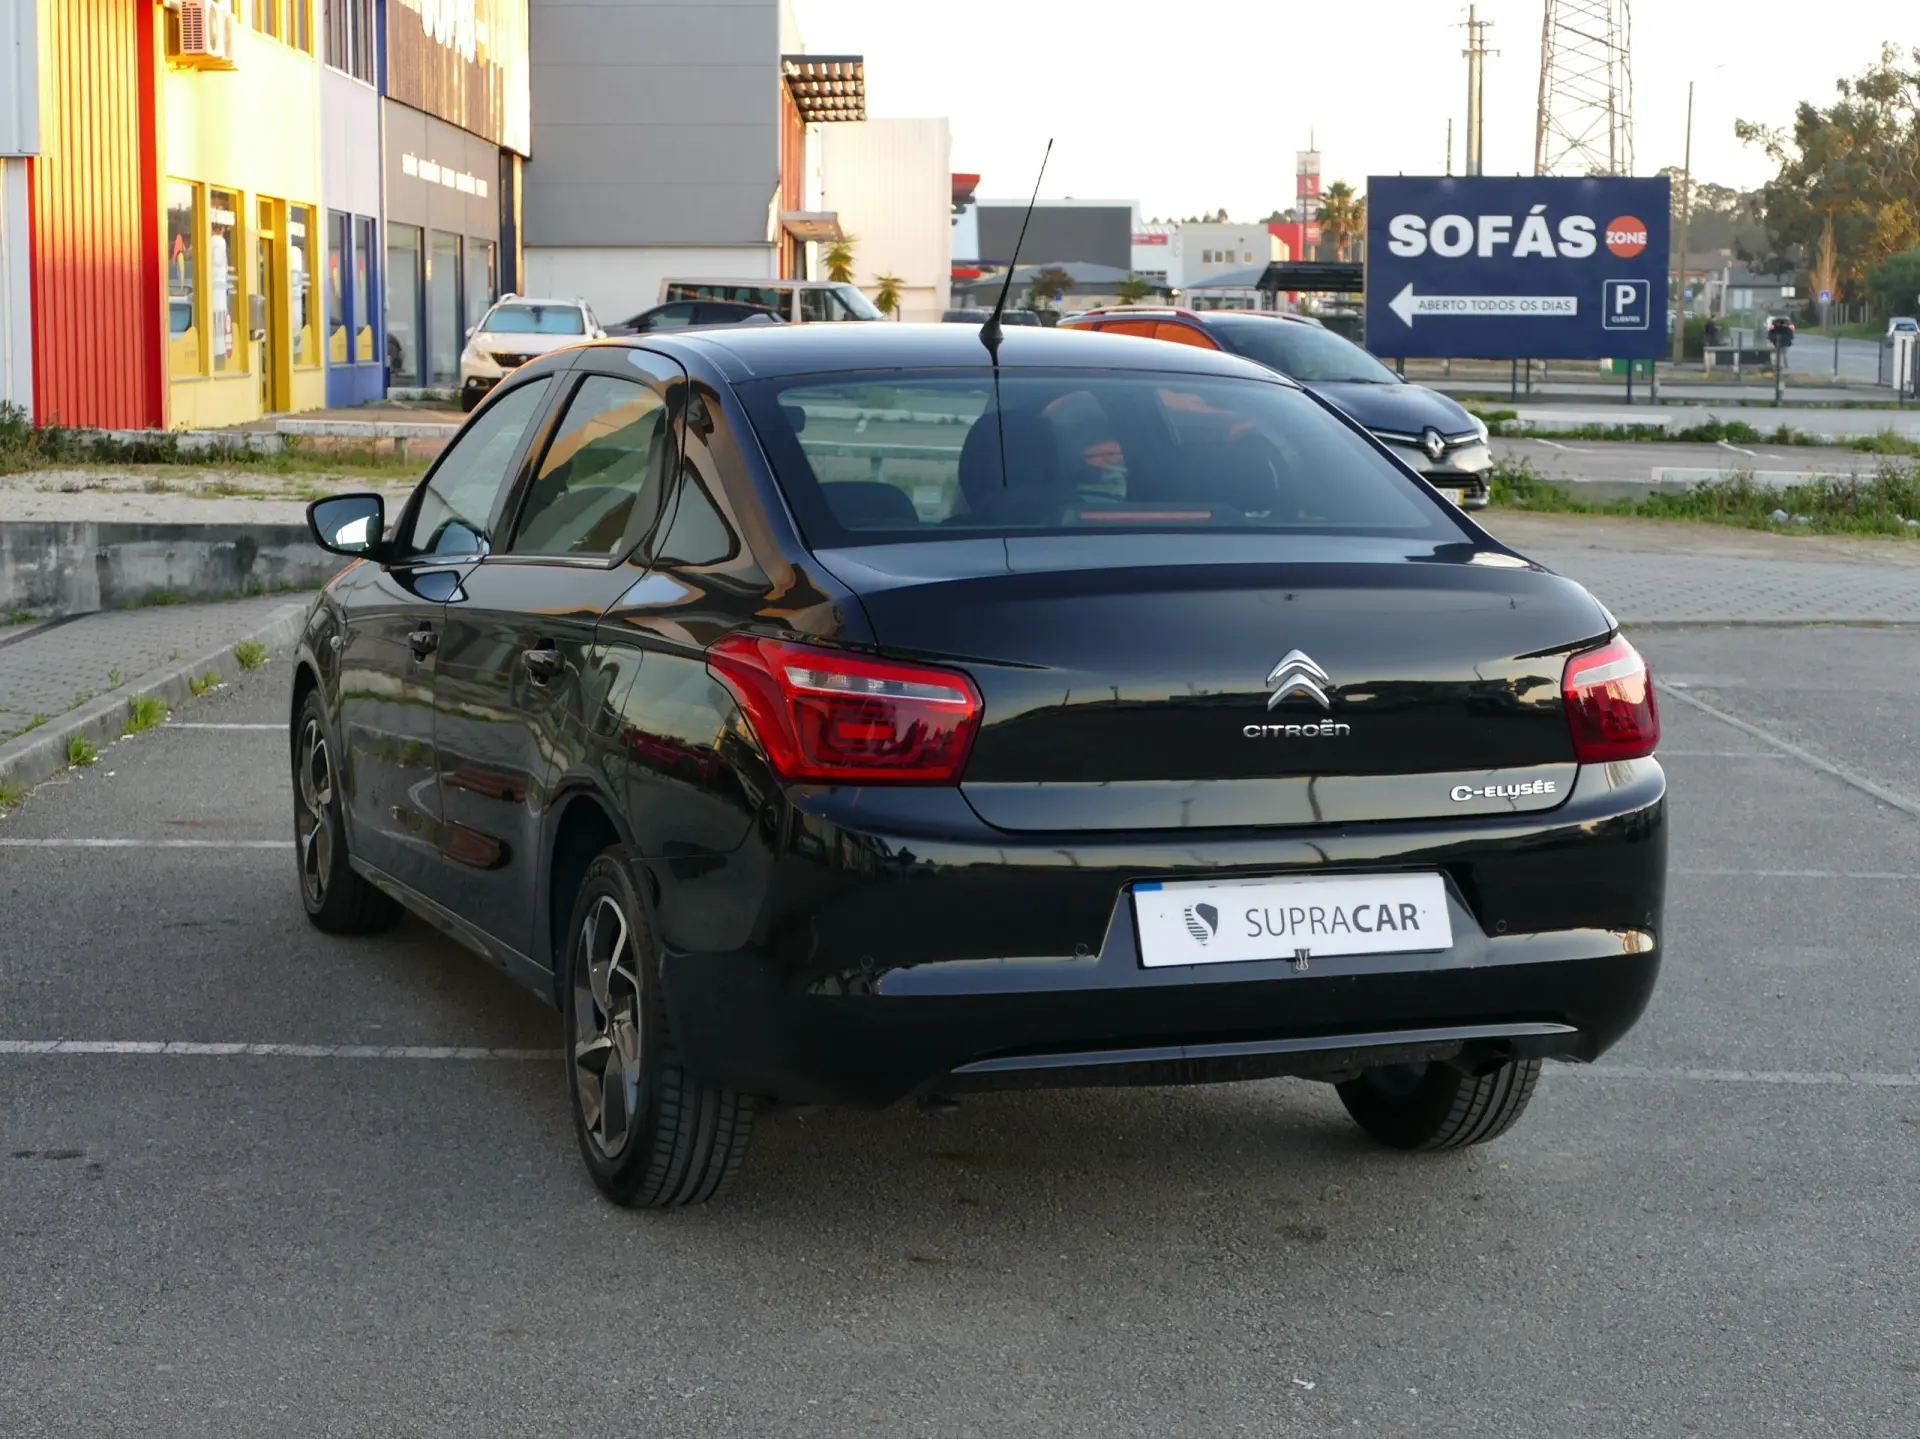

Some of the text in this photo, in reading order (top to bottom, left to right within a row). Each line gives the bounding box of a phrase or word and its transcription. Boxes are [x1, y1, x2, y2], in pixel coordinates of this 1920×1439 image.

[1388, 204, 1597, 258] SOFÁS
[1605, 232, 1647, 245] ZONE
[1418, 299, 1571, 311] ABERTO TODOS OS DIAS
[1615, 285, 1636, 314] P
[1246, 903, 1420, 938] SUPRACAR
